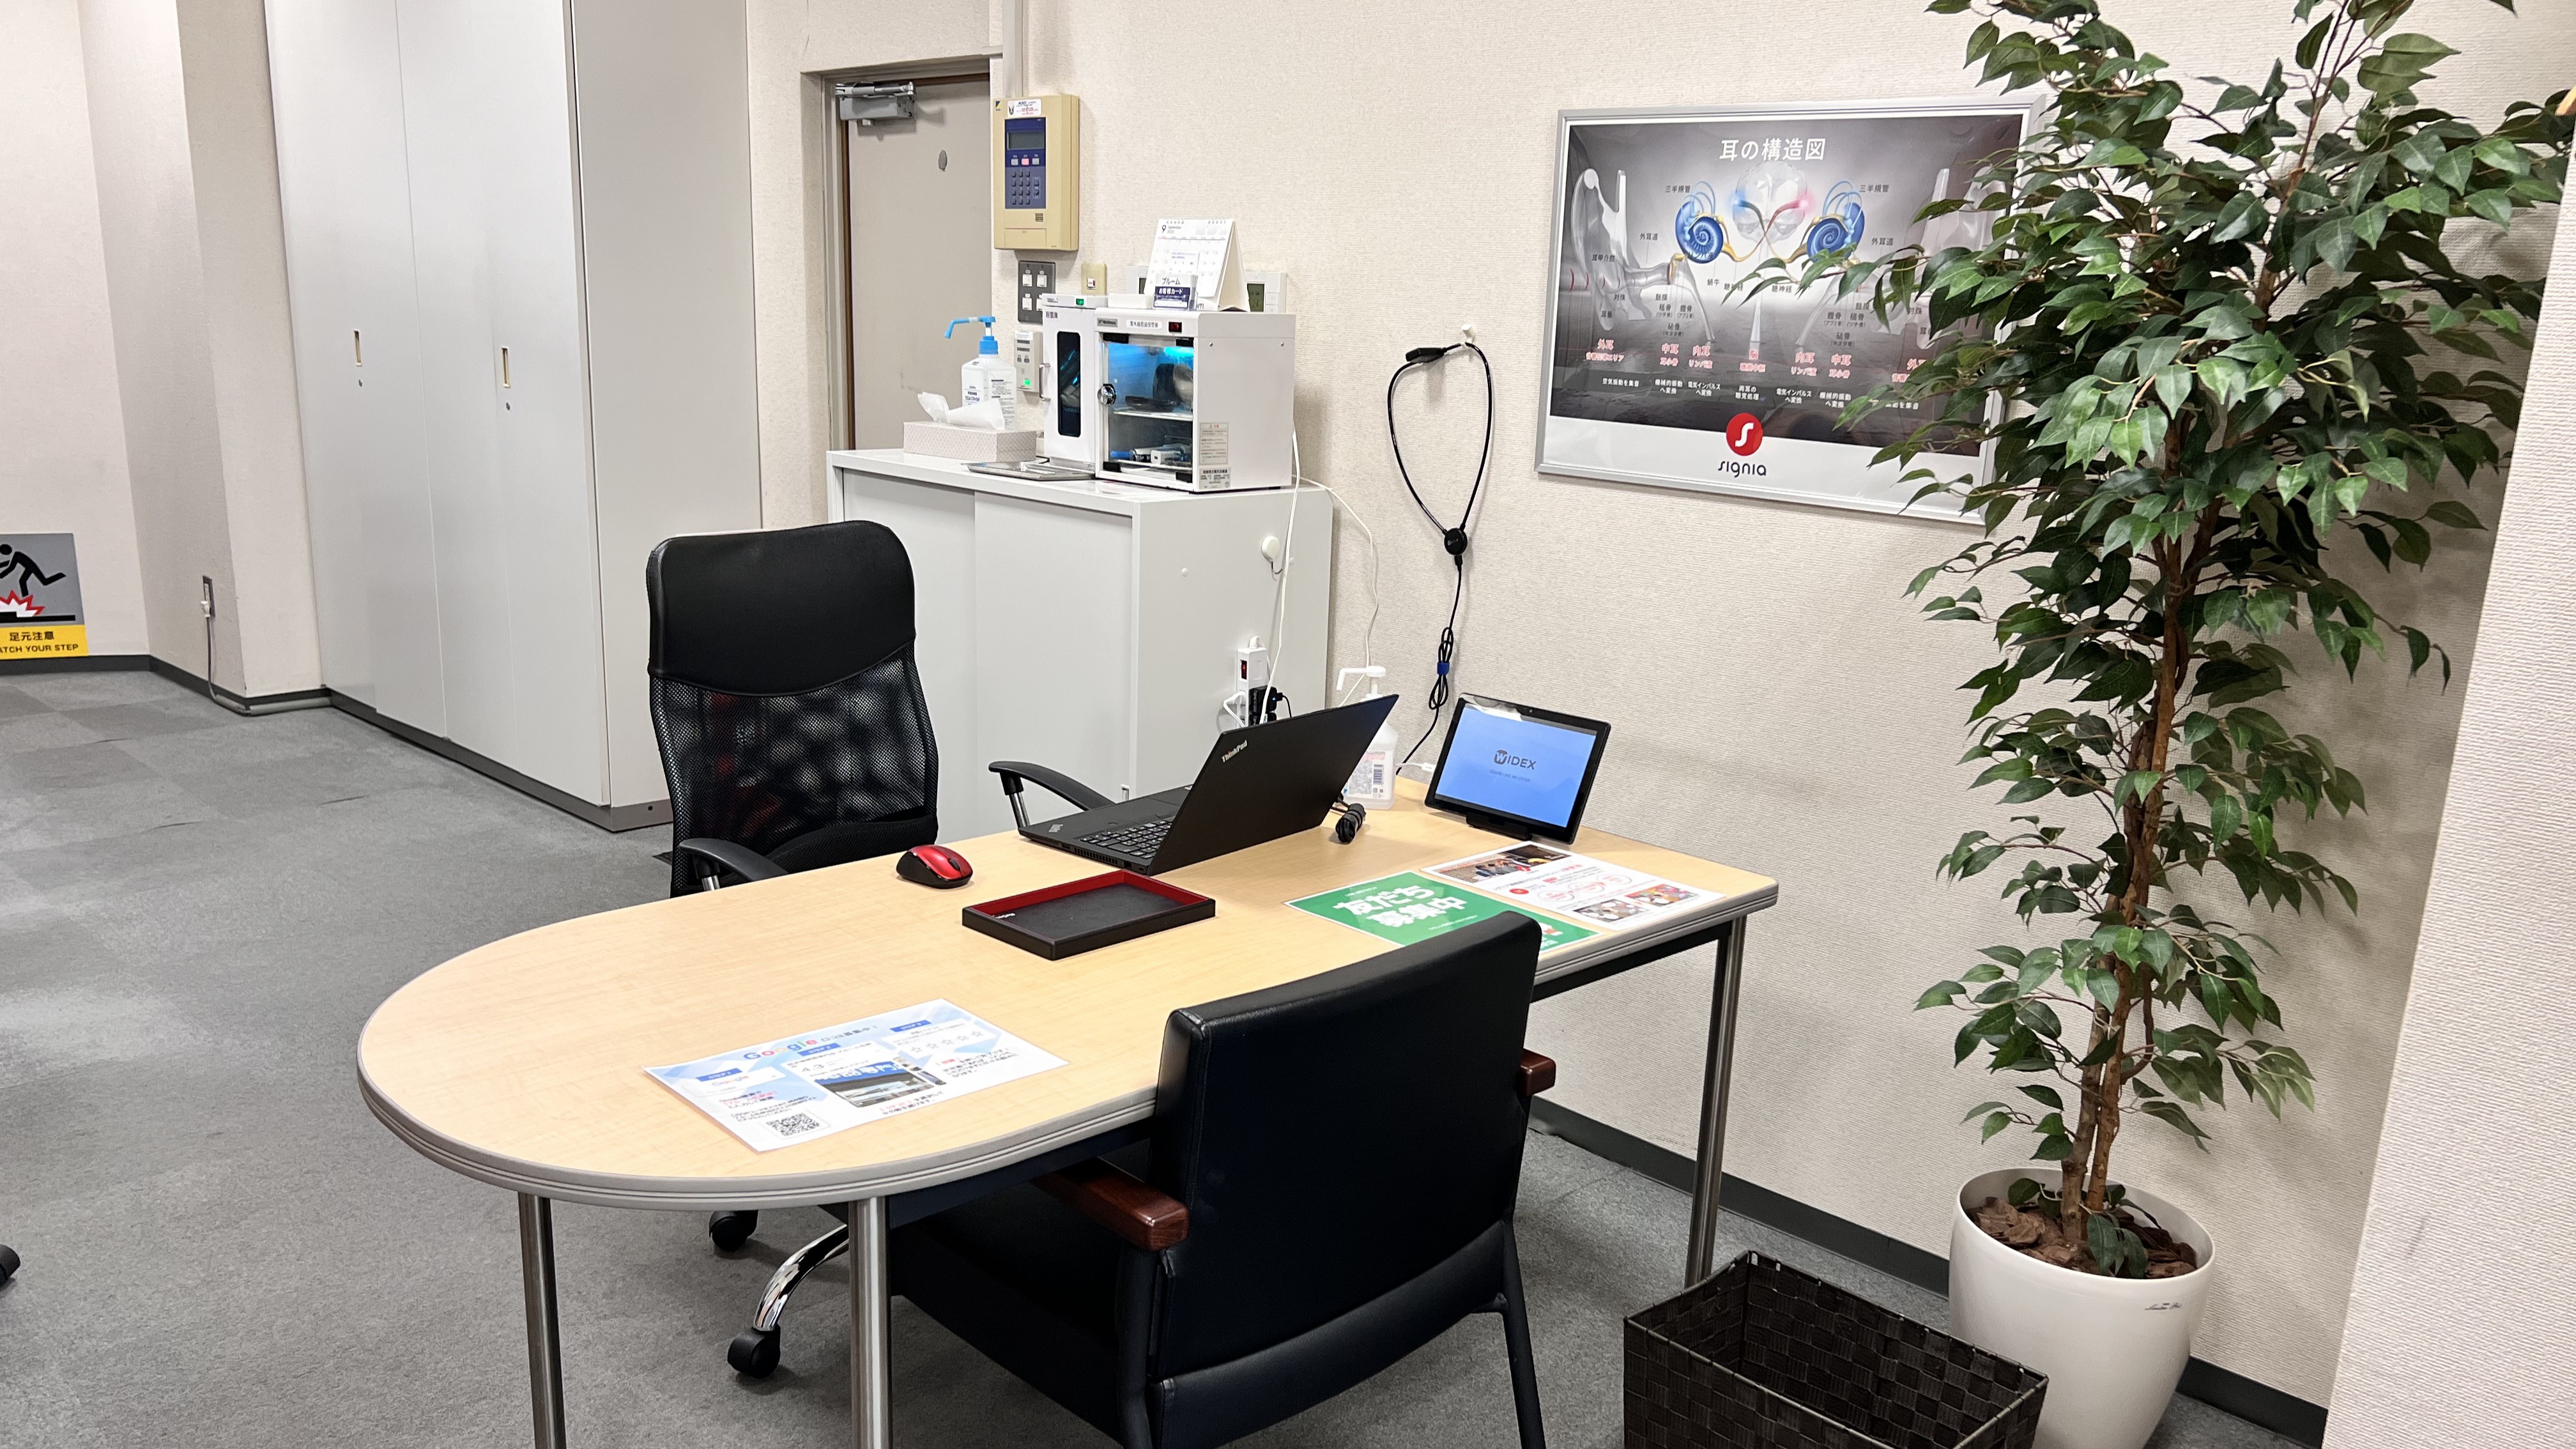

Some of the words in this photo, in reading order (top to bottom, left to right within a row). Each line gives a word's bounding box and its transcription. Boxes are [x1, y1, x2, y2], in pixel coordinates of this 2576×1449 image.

[1719, 137, 1826, 161] 耳の構造図
[1639, 233, 1659, 241] 外耳道
[1871, 238, 1894, 247] 外耳道
[1162, 277, 1181, 286] ブルーム
[1771, 284, 1793, 293] 聴神経
[1597, 338, 1614, 350] 外耳
[1661, 343, 1679, 355] 中耳
[1692, 344, 1711, 357] 内耳
[1795, 351, 1816, 364] 内耳
[1831, 353, 1851, 366] 中耳
[1687, 381, 1721, 390] 電気インパルス
[1776, 387, 1812, 397] 電気インパルス
[10, 631, 54, 641] 足元注意
[1221, 739, 1248, 763] ThinkPad
[1494, 749, 1537, 770] WIDEX
[1332, 885, 1435, 916] 友だち
[1366, 896, 1468, 928] 募集中
[744, 1039, 818, 1060] Google
